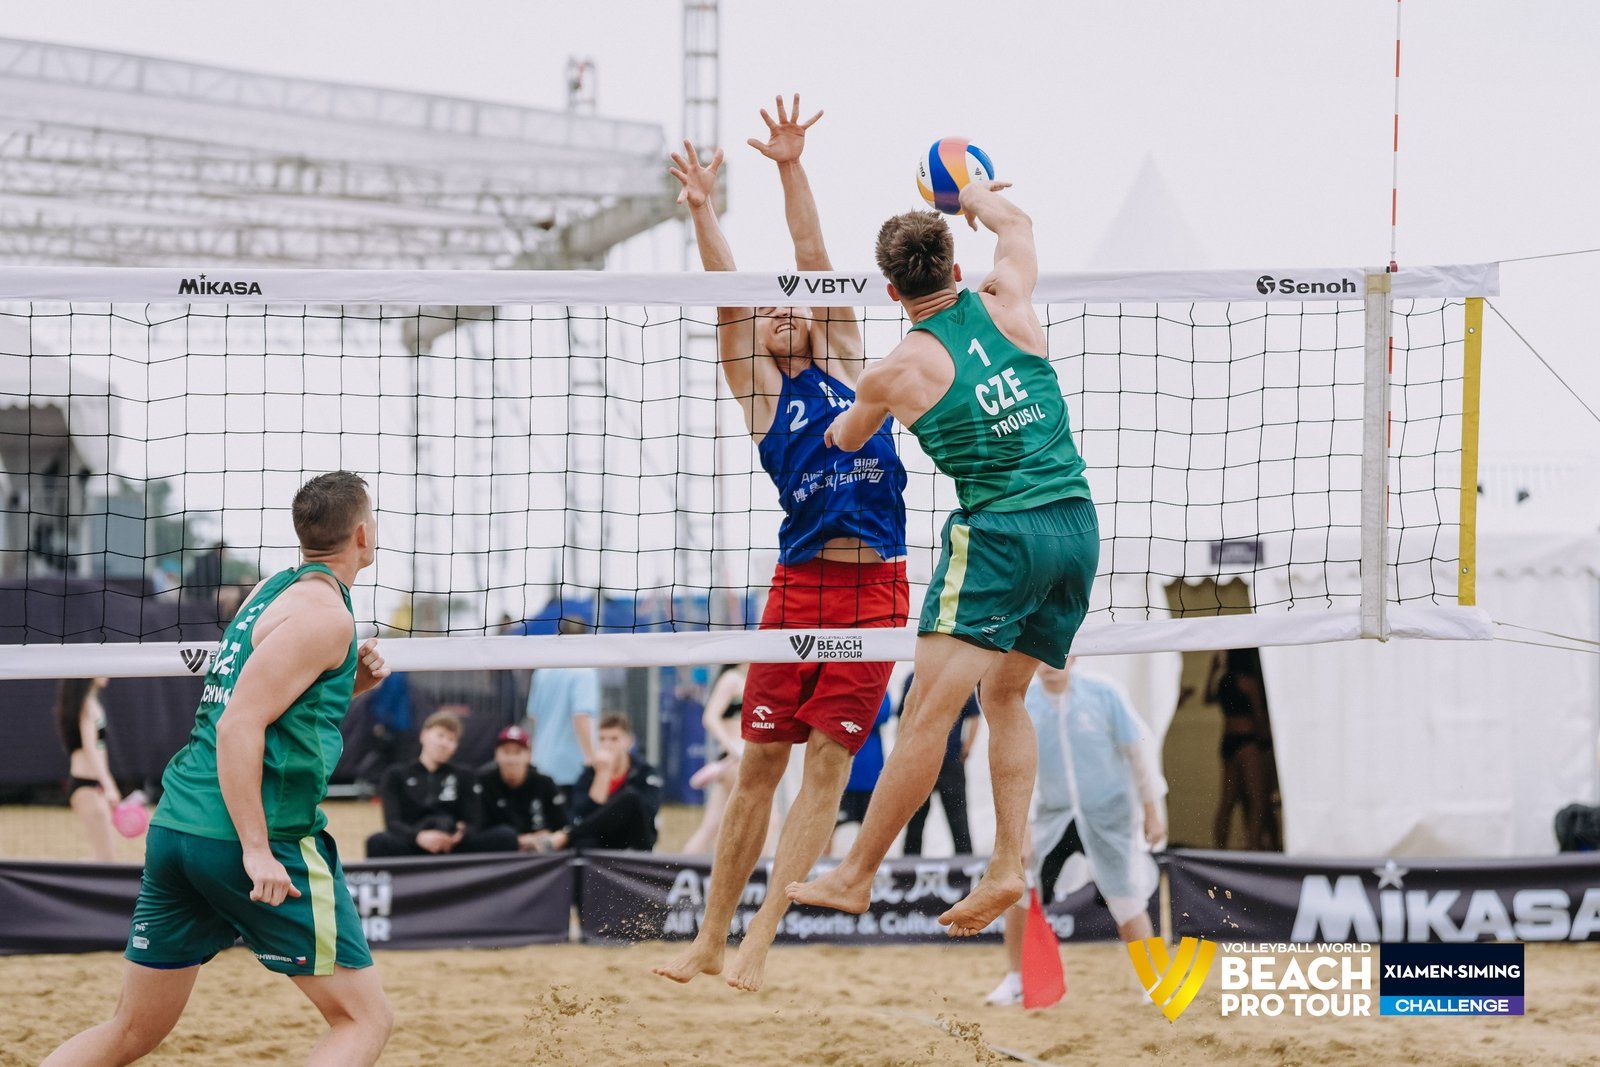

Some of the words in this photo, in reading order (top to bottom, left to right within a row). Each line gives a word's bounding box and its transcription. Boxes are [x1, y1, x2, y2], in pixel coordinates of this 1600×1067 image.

[804, 278, 867, 293] VBTV
[1279, 278, 1356, 294] Senoh
[968, 338, 991, 367] 1
[975, 367, 1028, 416] CZE
[786, 400, 808, 432] 2
[817, 640, 863, 650] BEACH
[817, 651, 837, 659] PRO
[838, 651, 863, 659] TOUR
[752, 721, 775, 729] ORLEN
[784, 911, 855, 939] Sports
